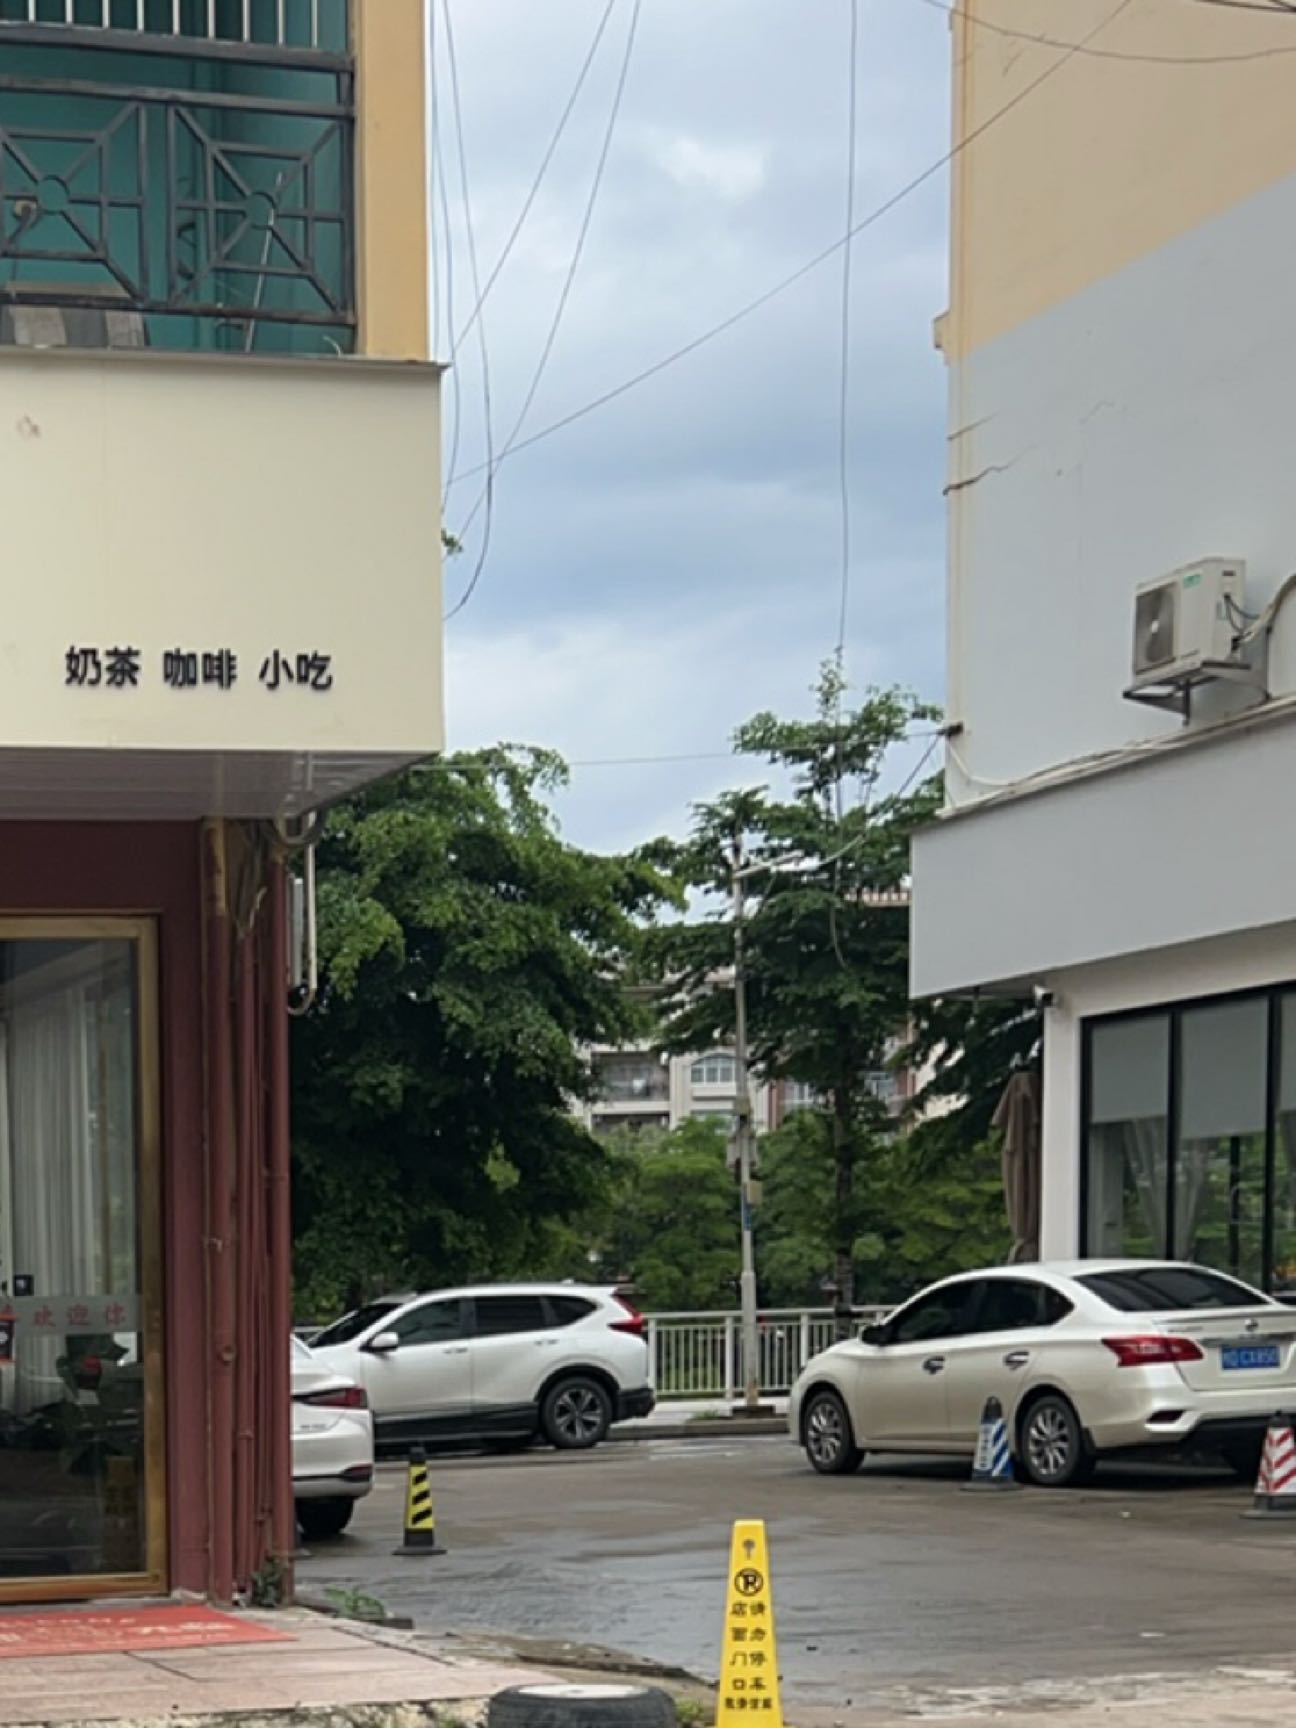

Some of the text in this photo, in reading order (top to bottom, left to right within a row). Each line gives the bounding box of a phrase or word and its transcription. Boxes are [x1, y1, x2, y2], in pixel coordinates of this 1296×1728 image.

[64, 645, 333, 691] 奶茶 咖啡 小吃
